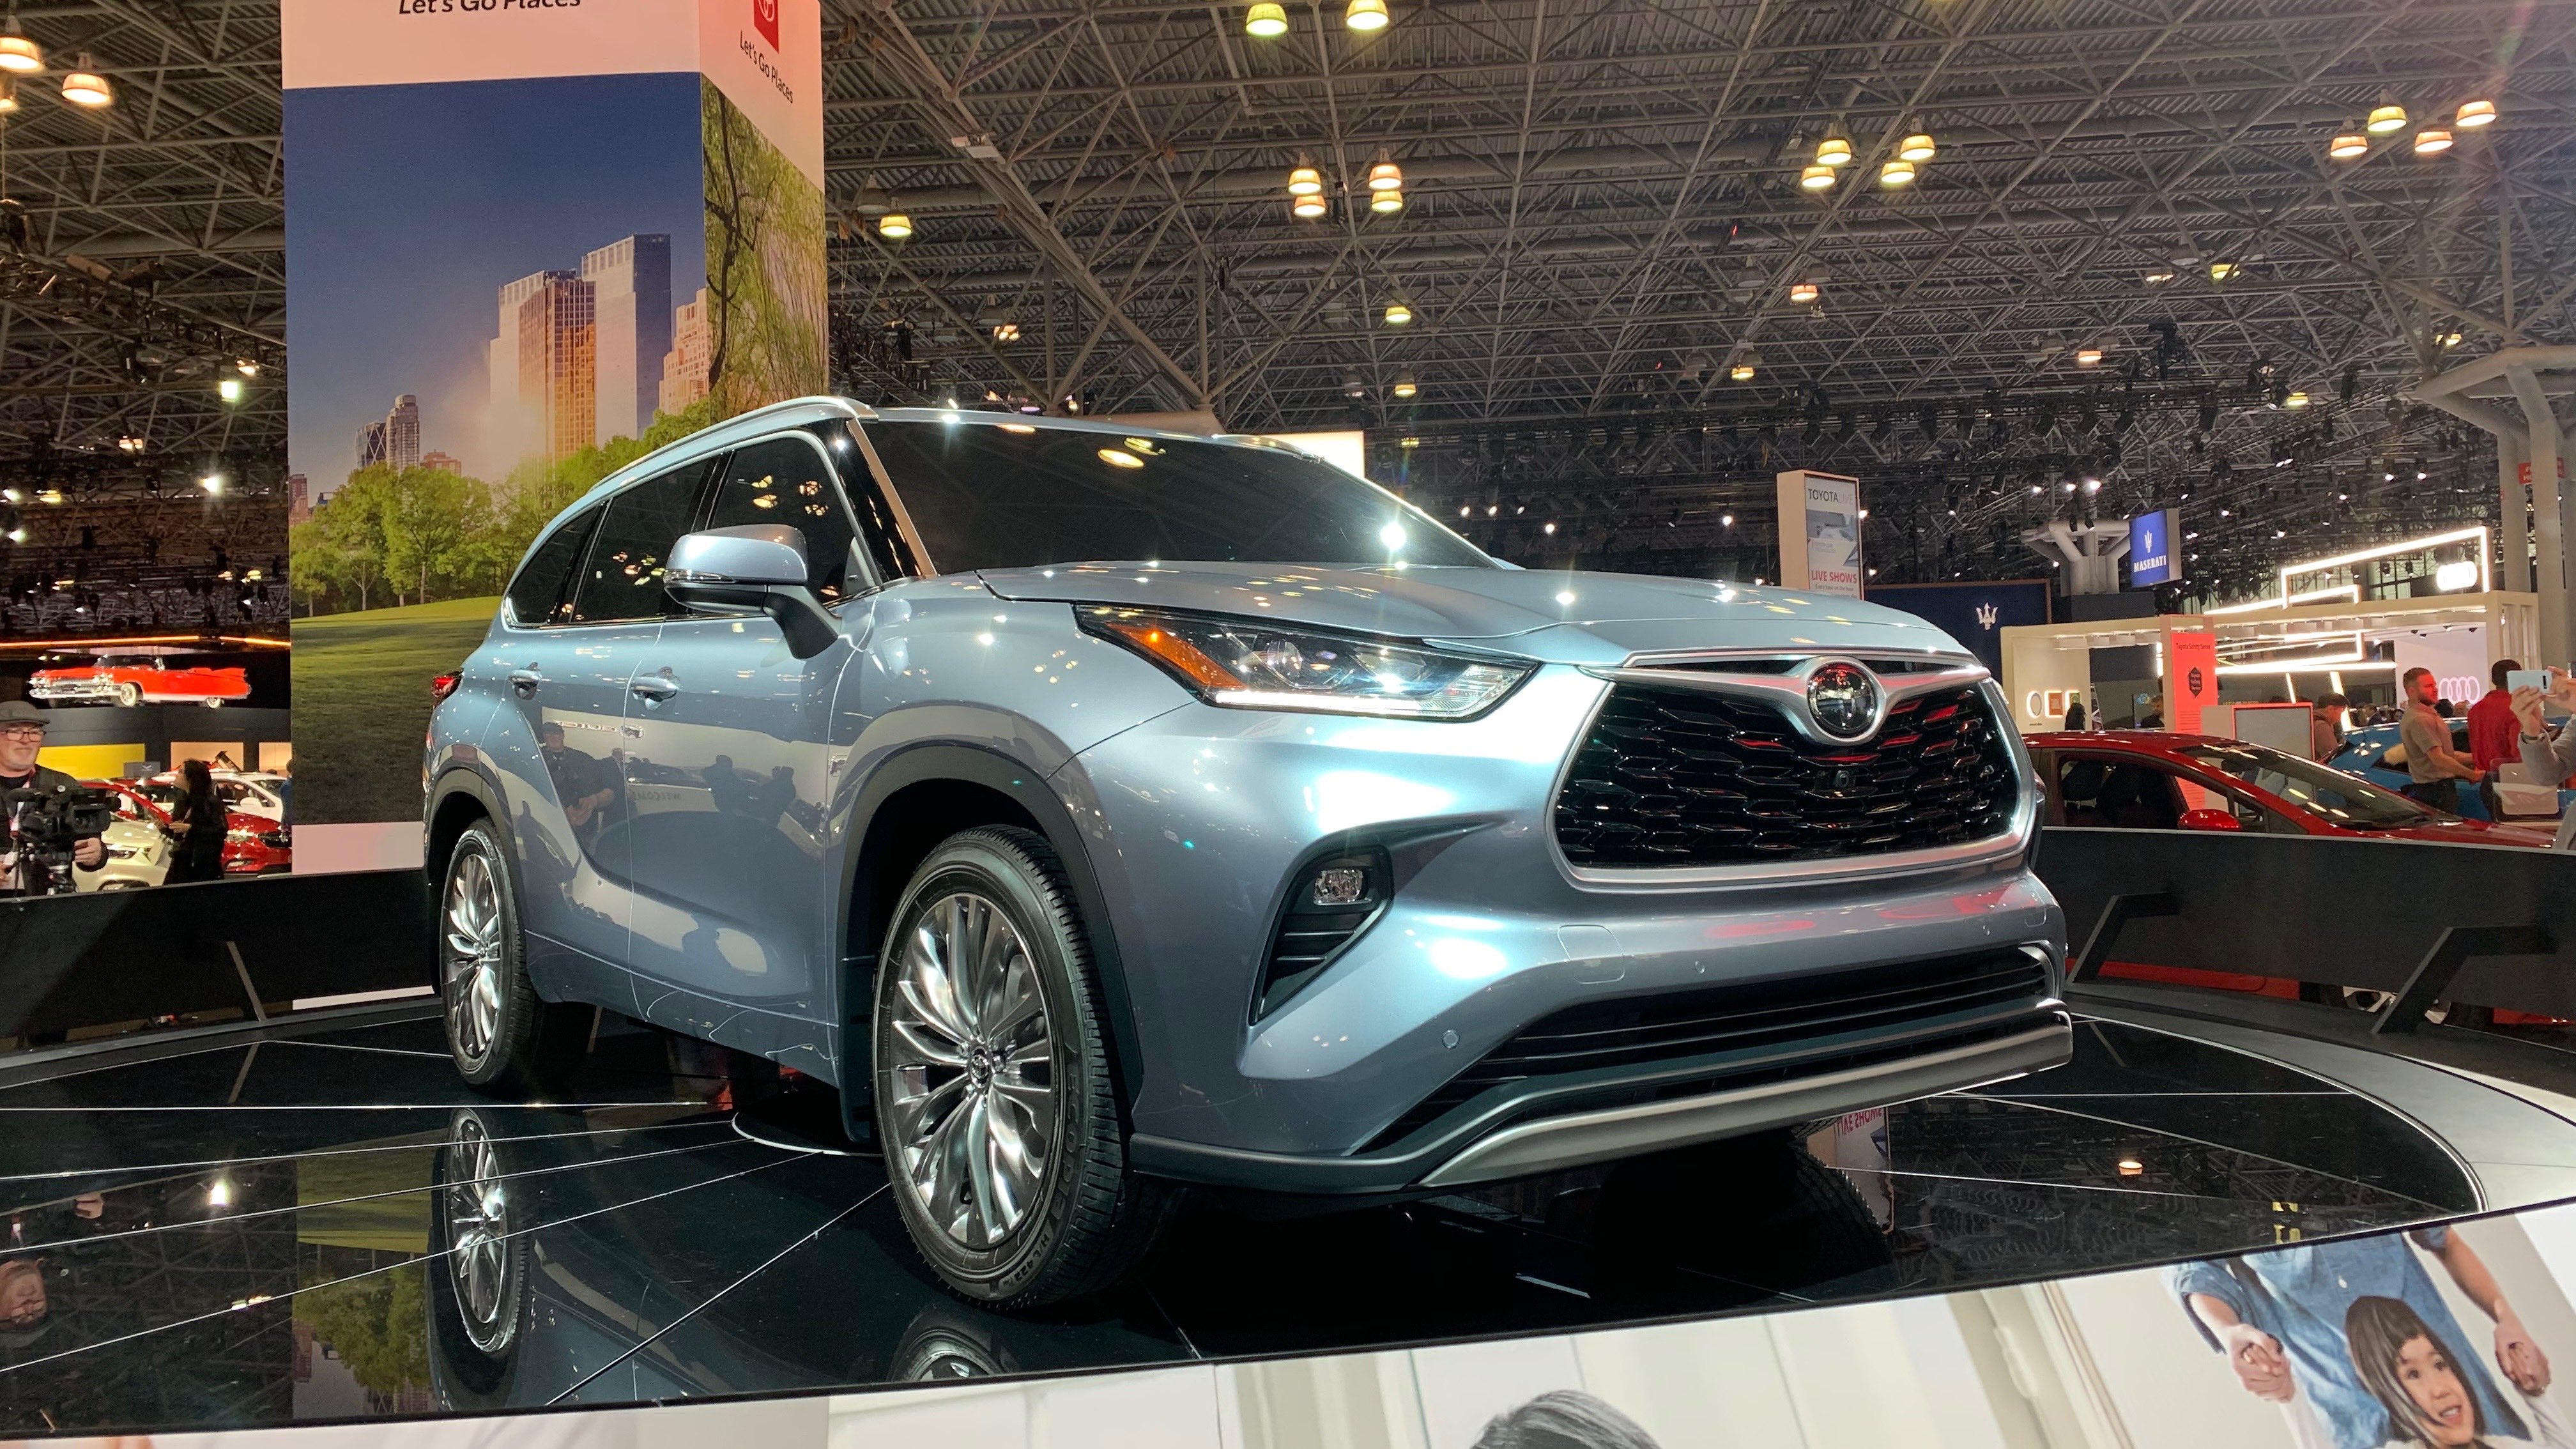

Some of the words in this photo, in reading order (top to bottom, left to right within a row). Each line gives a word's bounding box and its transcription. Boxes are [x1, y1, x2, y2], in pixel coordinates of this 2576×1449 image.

[399, 0, 452, 14] Lets
[740, 30, 757, 65] Let's
[758, 52, 770, 77] Go
[771, 66, 793, 103] Places
[2133, 555, 2167, 572] MASERATI
[1811, 570, 1828, 581] LIVE
[1829, 571, 1857, 584] SHOWS
